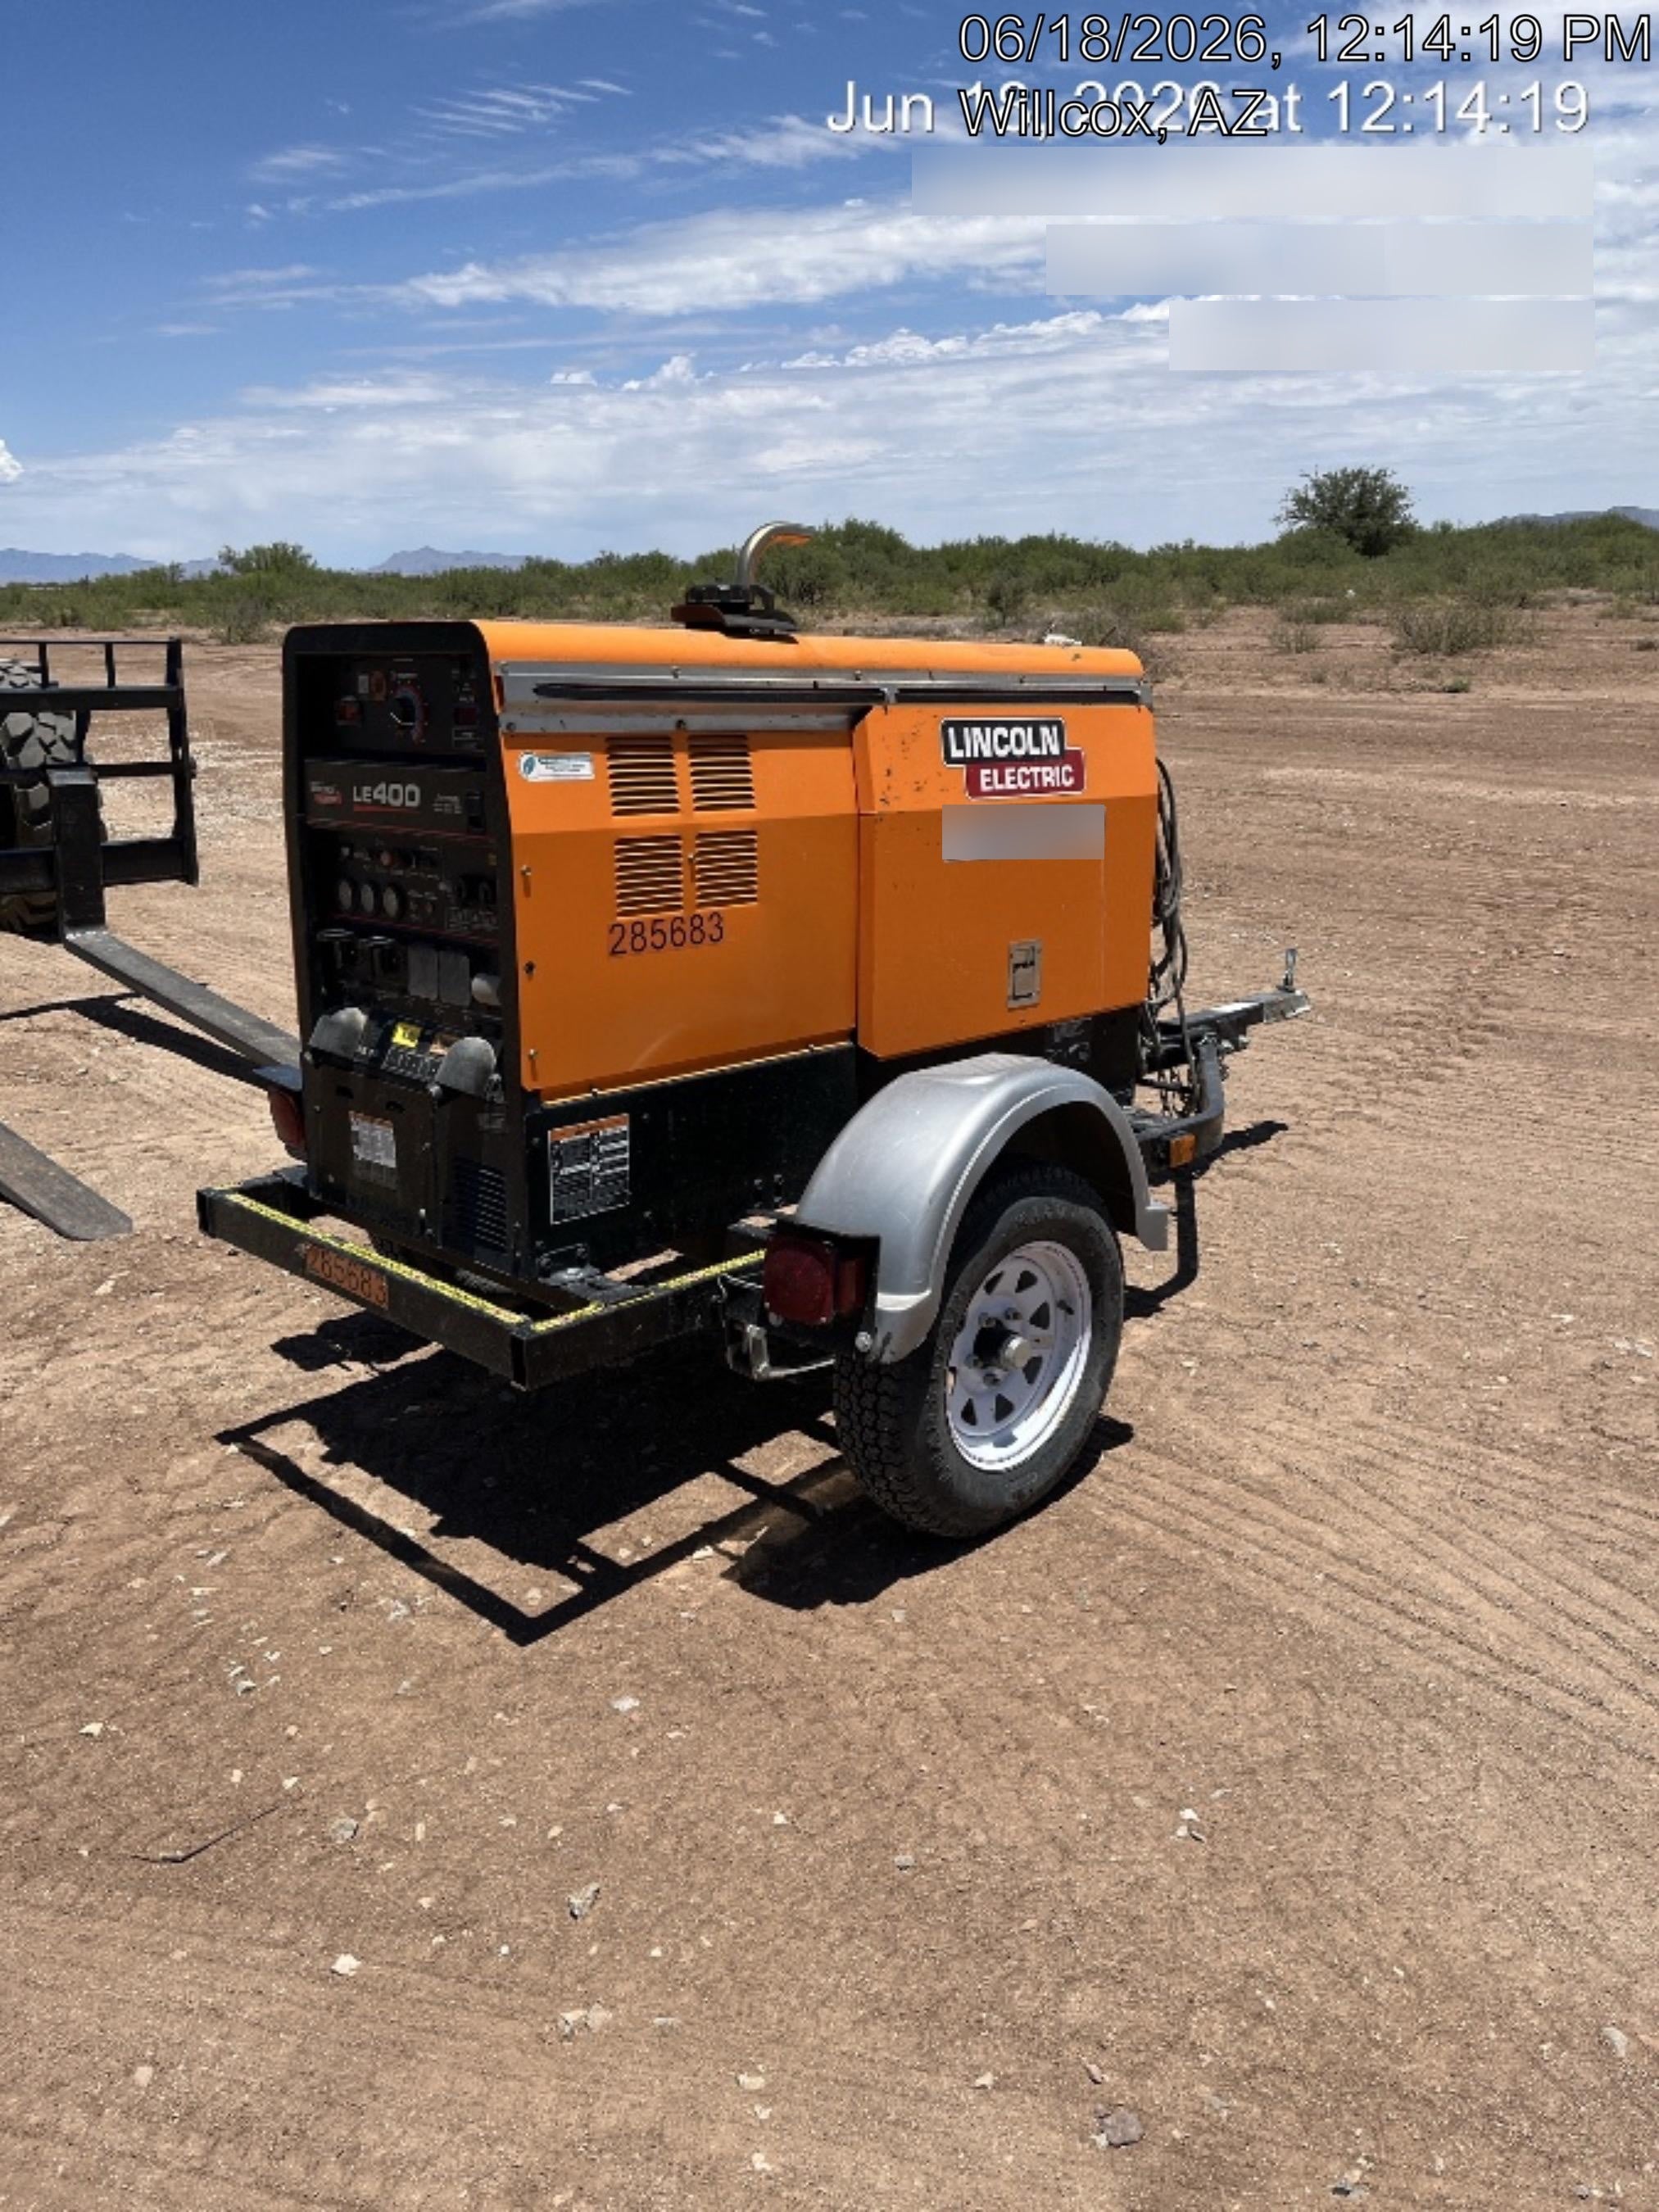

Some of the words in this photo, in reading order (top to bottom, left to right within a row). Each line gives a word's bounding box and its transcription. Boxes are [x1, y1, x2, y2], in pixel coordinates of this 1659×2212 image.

[948, 726, 1060, 758] LINCOLN
[980, 764, 1075, 791] ELECTRIC
[353, 782, 421, 807] LE400
[609, 911, 724, 957] 285683
